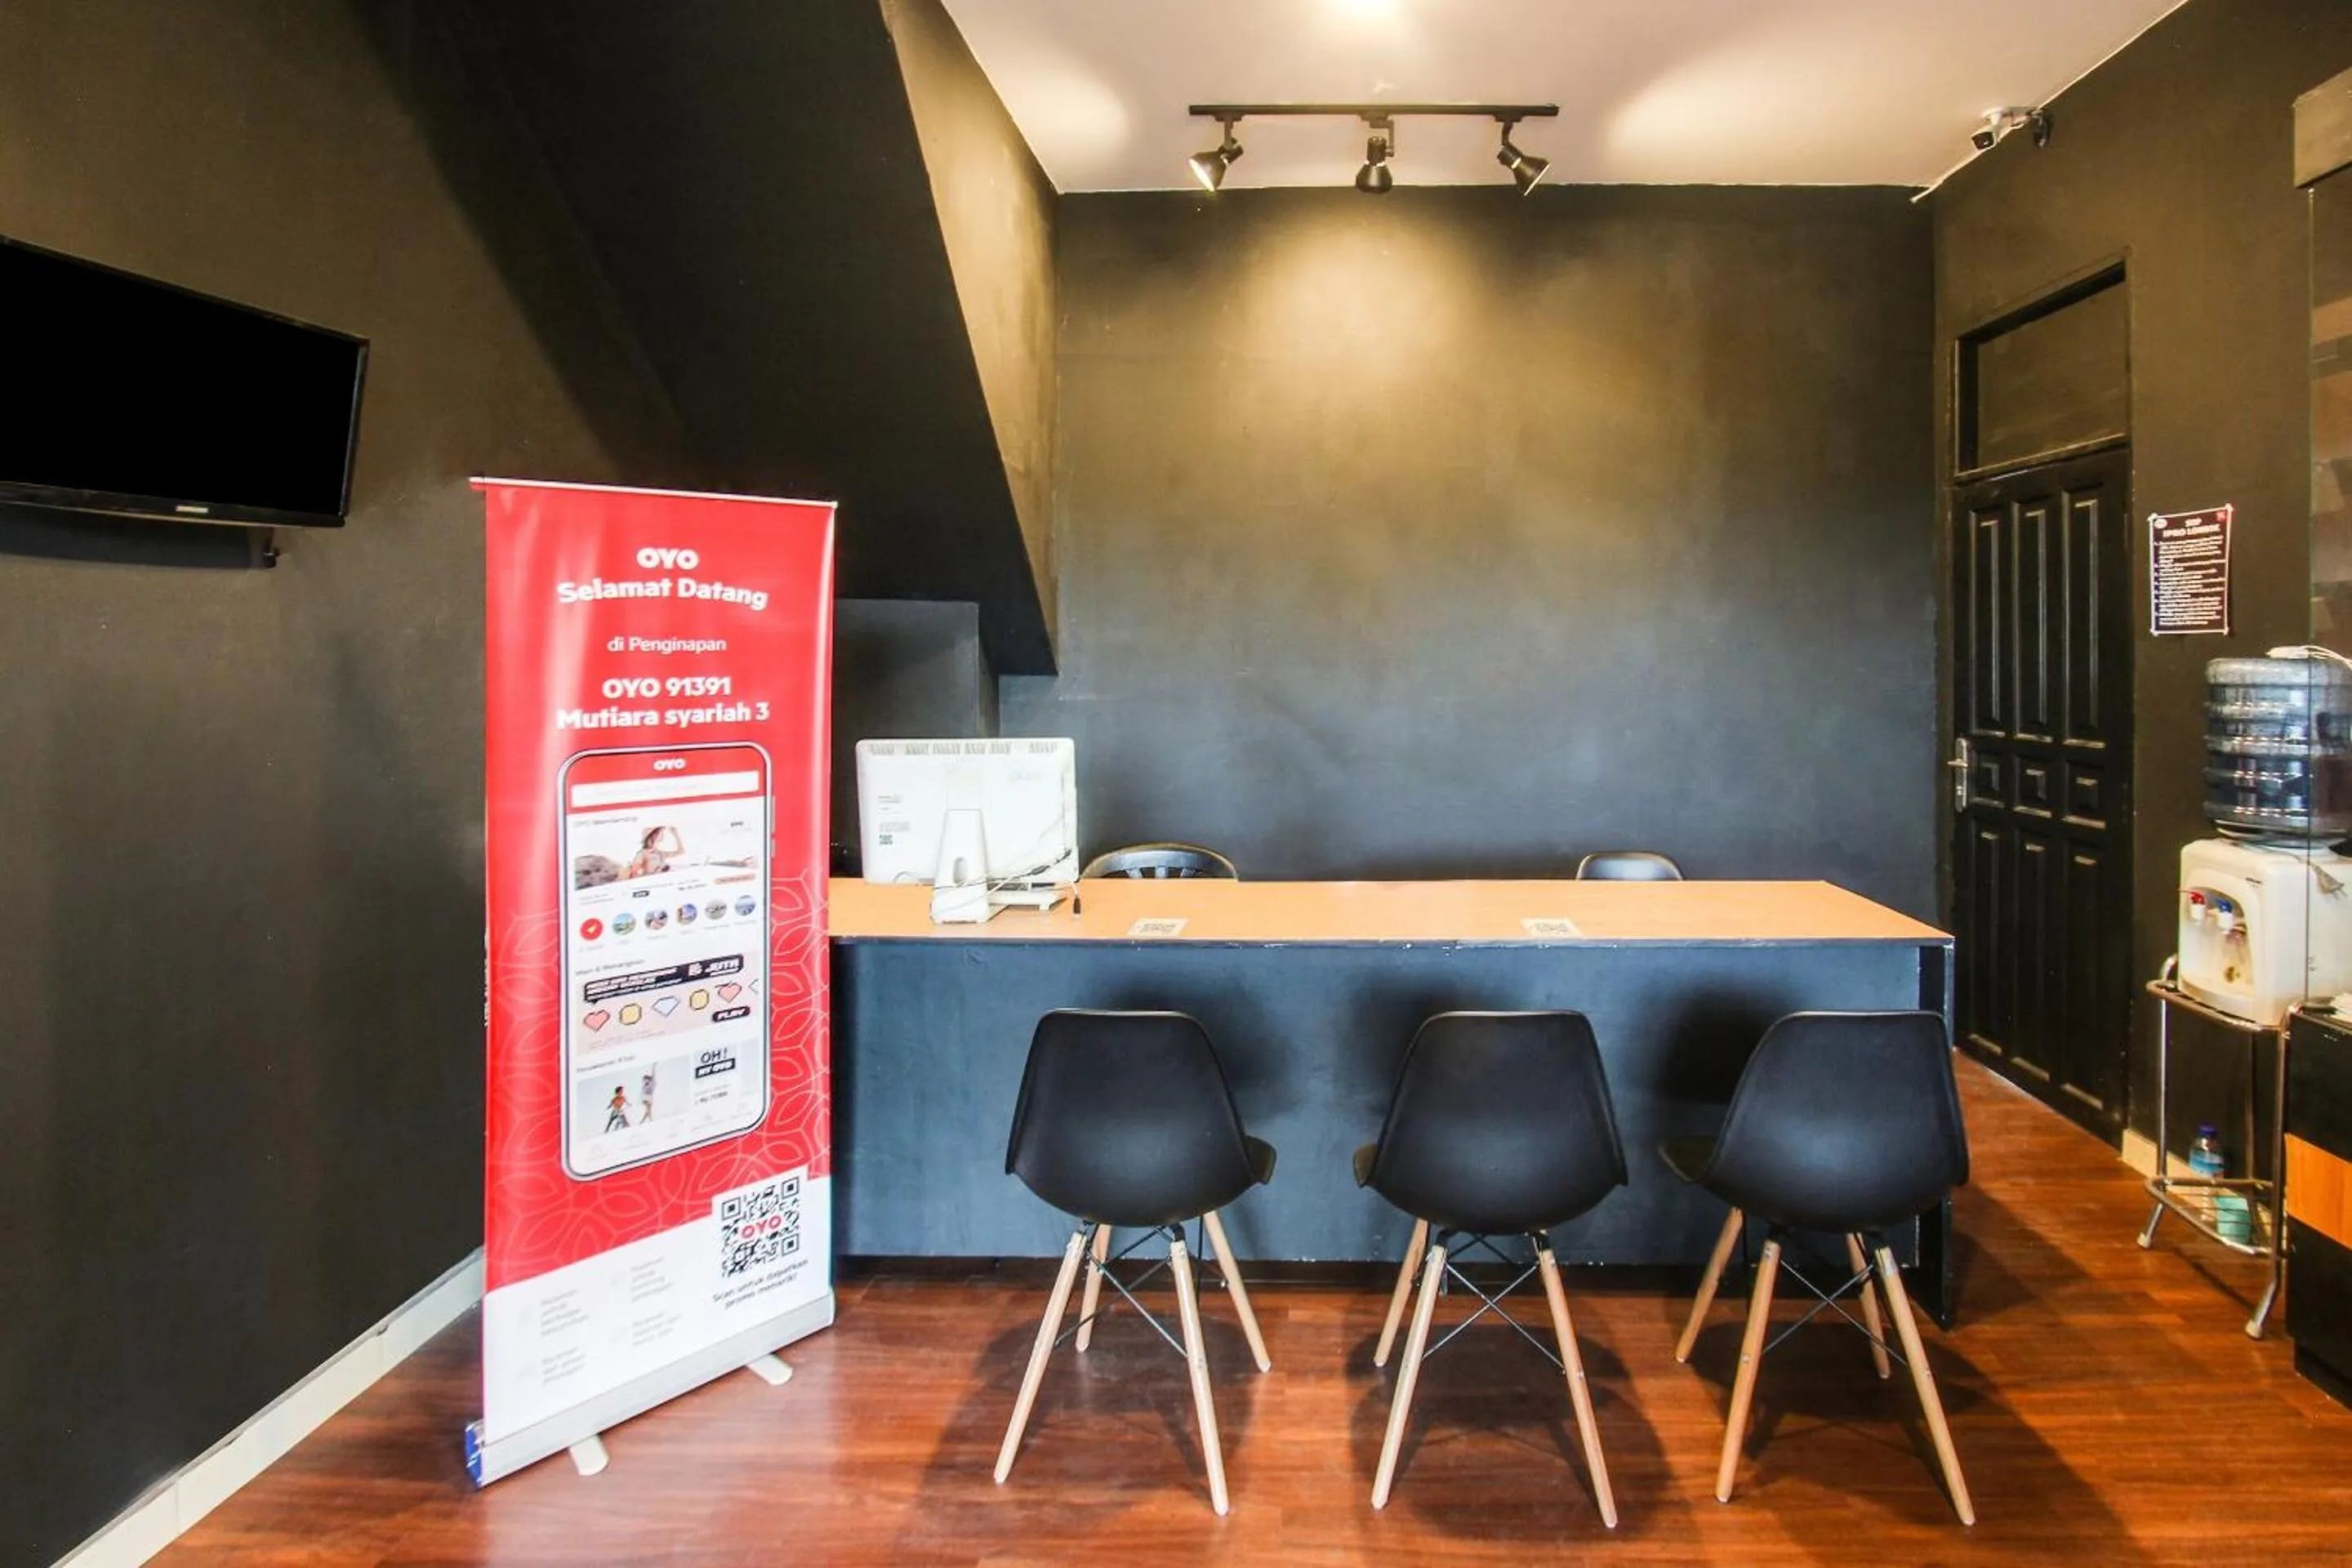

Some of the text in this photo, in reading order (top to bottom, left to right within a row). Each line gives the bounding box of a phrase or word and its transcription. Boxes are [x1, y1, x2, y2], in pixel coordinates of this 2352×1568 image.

[636, 547, 700, 570] OYO
[557, 577, 768, 611] Selamat Datang
[608, 637, 727, 654] di Penginapan
[602, 676, 731, 699] OYO 91391
[555, 702, 770, 729] Mutiara syariah 3
[653, 758, 686, 770] OYO
[741, 1214, 782, 1239] OYO
